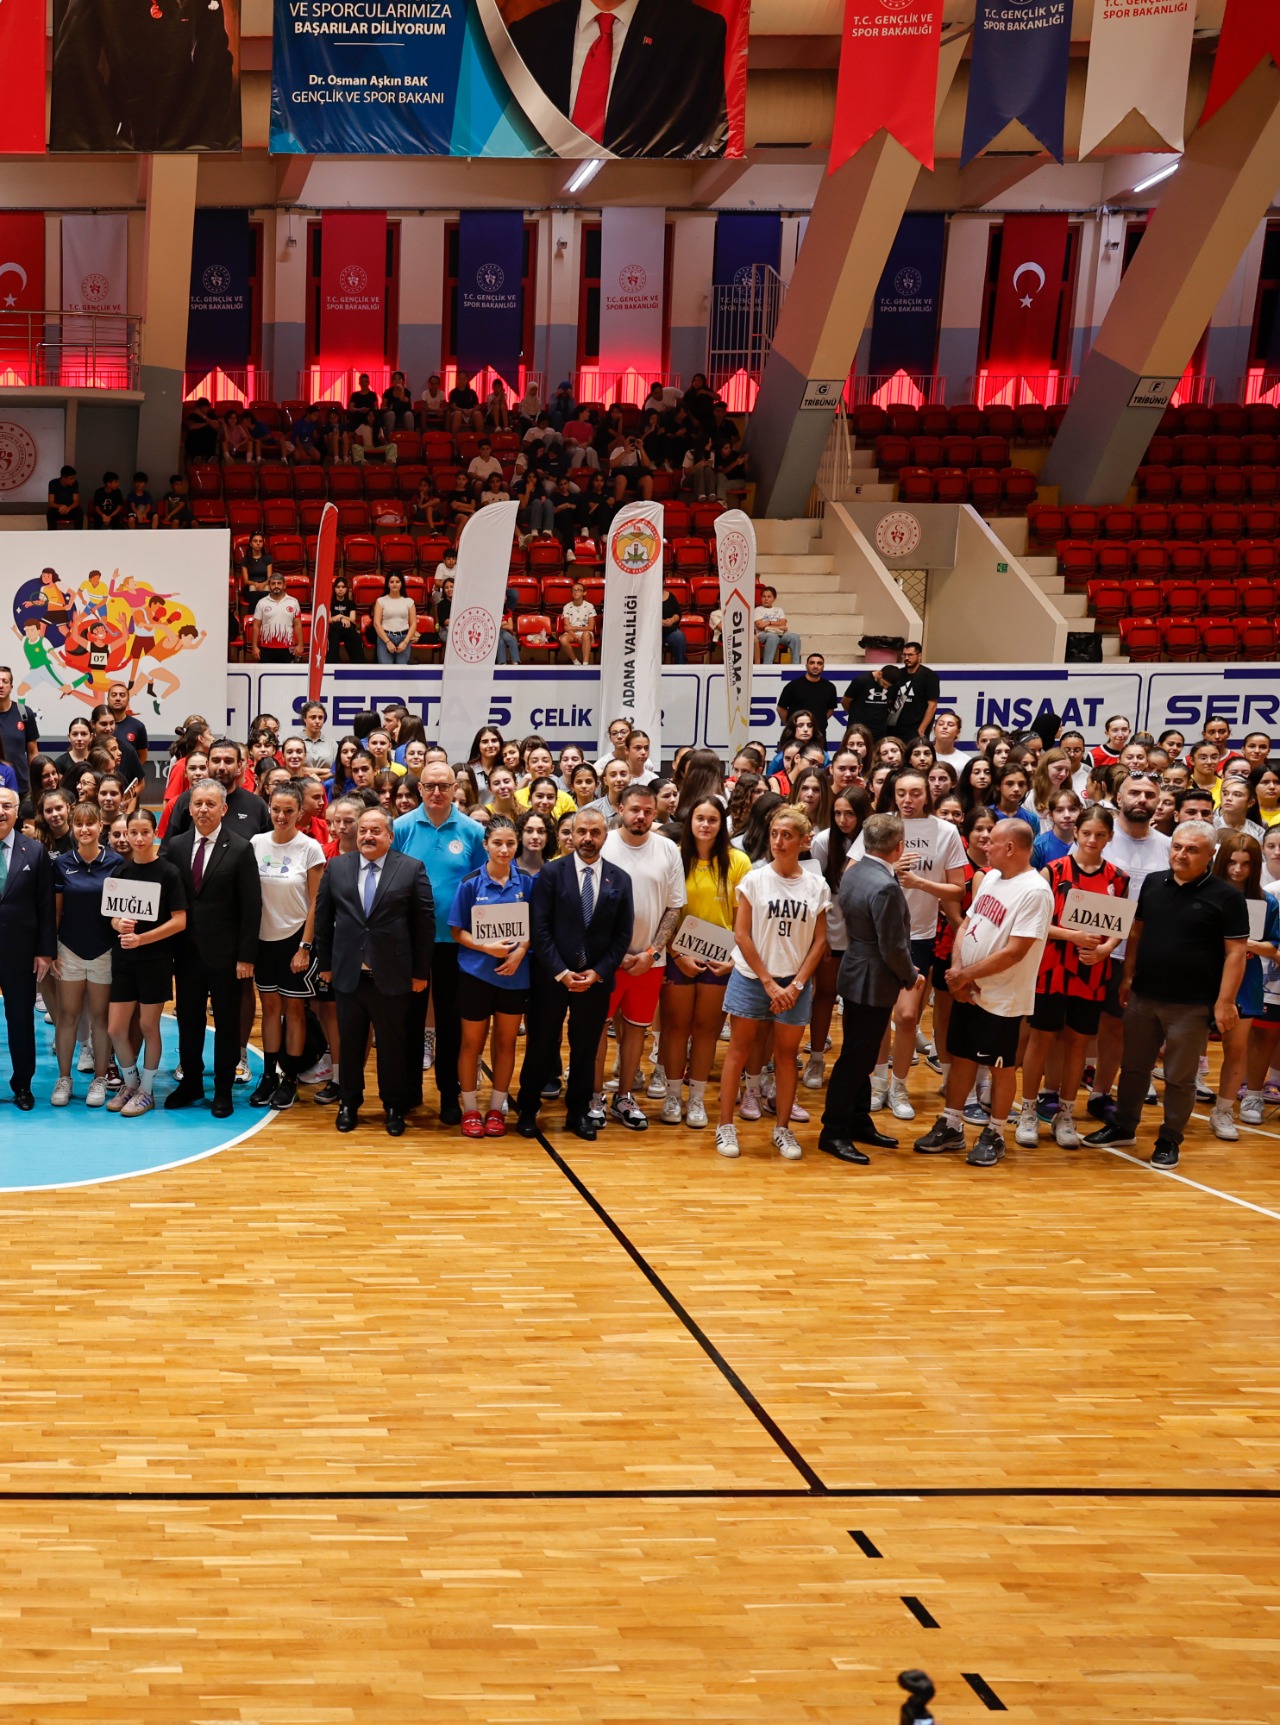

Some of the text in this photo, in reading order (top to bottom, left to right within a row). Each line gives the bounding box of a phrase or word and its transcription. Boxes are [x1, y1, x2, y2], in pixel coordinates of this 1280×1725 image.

[289, 2, 452, 19] VE SPORCULARIMIZA
[853, 12, 933, 26] T.C. GENÇLİK VE
[984, 3, 1065, 20] T.C. GENÇLİK VE
[1103, 9, 1130, 20] SPOR
[1132, 2, 1188, 17] BAKANLIĞI
[294, 20, 446, 38] BAŞARILAR DİLİYORUM
[852, 24, 932, 37] SPOR BAKANLIĞI
[983, 14, 1064, 31] SPOR BAKANLIĞI
[308, 74, 428, 88] Dr. Osman Aşkın BAK
[291, 90, 444, 105] GENÇLİK VE SPOR BAKANI
[818, 385, 828, 394] G
[1152, 382, 1161, 392] F
[622, 594, 638, 708] ADANA VALİLİĞİ
[529, 704, 593, 730] ÇELİK
[1164, 694, 1280, 725] SER
[105, 895, 154, 916] MUĞLA
[768, 898, 808, 923] MAVİ
[778, 920, 792, 937] 91
[1068, 908, 1123, 932] ADANA
[476, 920, 525, 940] İSTANBUL
[675, 932, 728, 962] ANTALYA
